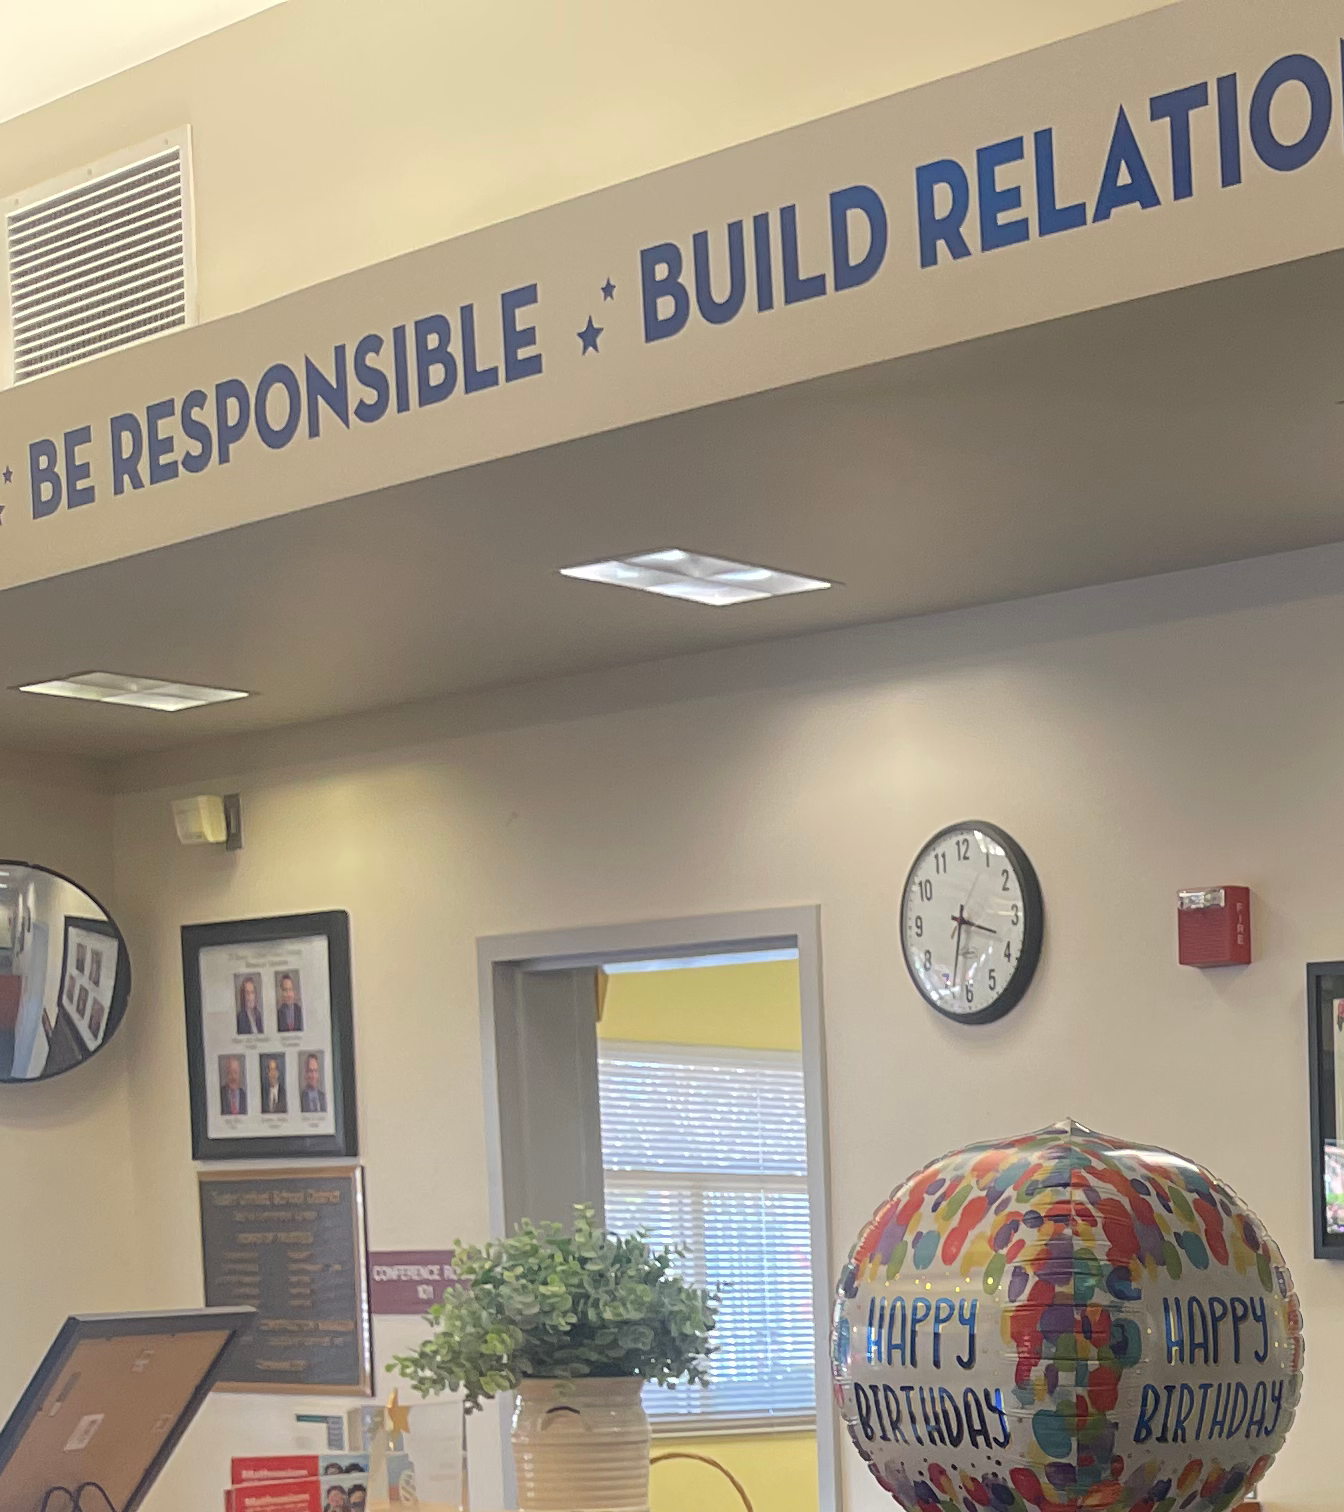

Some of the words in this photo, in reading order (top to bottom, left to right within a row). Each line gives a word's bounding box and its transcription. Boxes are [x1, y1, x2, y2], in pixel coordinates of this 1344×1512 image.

[28, 425, 96, 520] BE
[110, 283, 543, 497] RESPONSIBLE
[640, 184, 888, 344] BUILD
[956, 838, 970, 861] 12
[934, 851, 947, 874] 11
[918, 879, 932, 901] 10
[1001, 869, 1010, 891] 2
[915, 915, 923, 938] 9
[1010, 904, 1019, 926] 3
[923, 950, 932, 972] 8
[1003, 941, 1011, 963] 4
[965, 980, 974, 1002] 6
[988, 968, 996, 991] 5
[373, 1265, 441, 1281] CONFERENCE
[866, 1295, 979, 1369] HAPPY
[1162, 1296, 1269, 1365] HAPPY
[853, 1382, 1012, 1449] BIRTHDAY
[1133, 1380, 1285, 1445] BIRTHDAY
